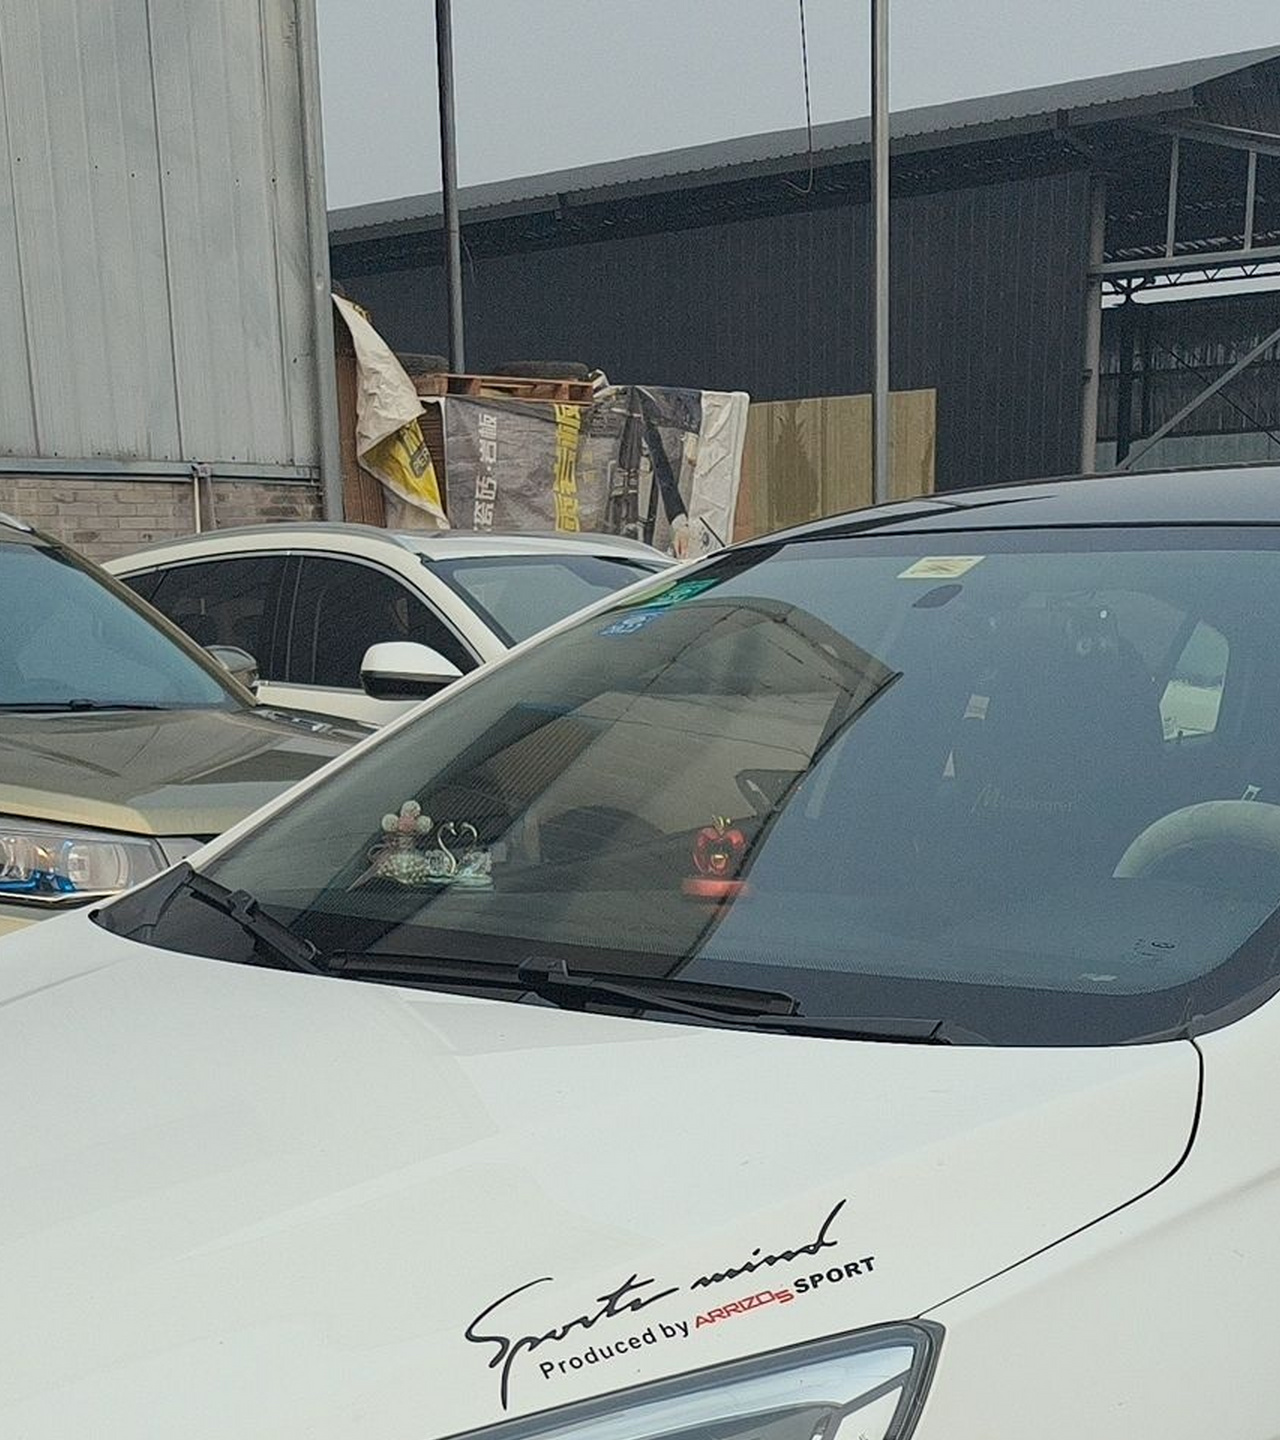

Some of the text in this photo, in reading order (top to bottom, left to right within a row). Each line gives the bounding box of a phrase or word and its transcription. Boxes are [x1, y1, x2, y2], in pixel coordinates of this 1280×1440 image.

[690, 1199, 848, 1290] mind
[538, 1327, 658, 1380] Produced
[660, 1318, 690, 1337] by
[794, 1256, 876, 1294] SPORT
